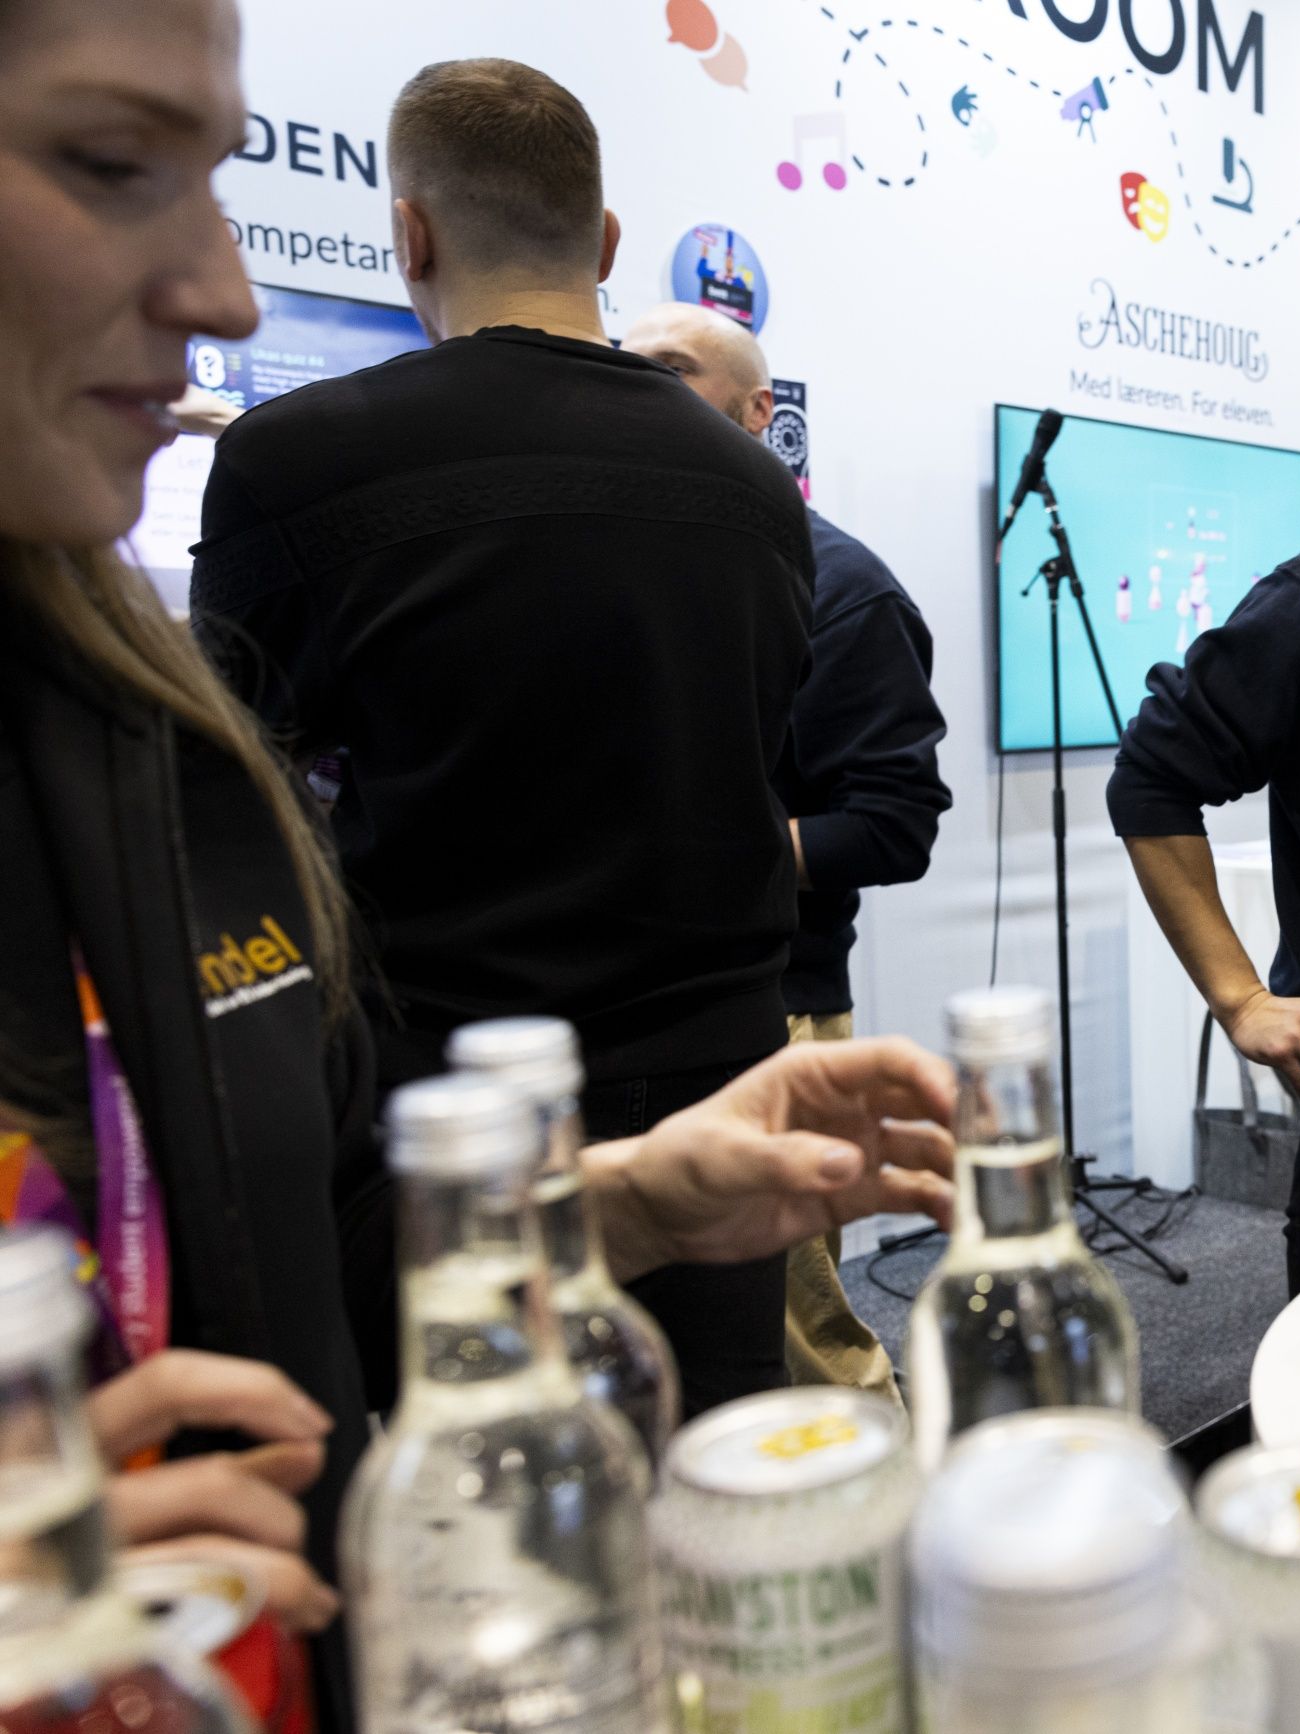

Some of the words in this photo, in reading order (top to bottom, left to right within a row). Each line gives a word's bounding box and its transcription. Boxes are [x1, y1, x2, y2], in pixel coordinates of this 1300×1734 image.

[1078, 277, 1269, 383] ASCHEHOUG
[1070, 367, 1112, 399] Med
[1118, 375, 1186, 412] læreren.
[1191, 390, 1218, 416] For
[1221, 396, 1275, 427] eleven.
